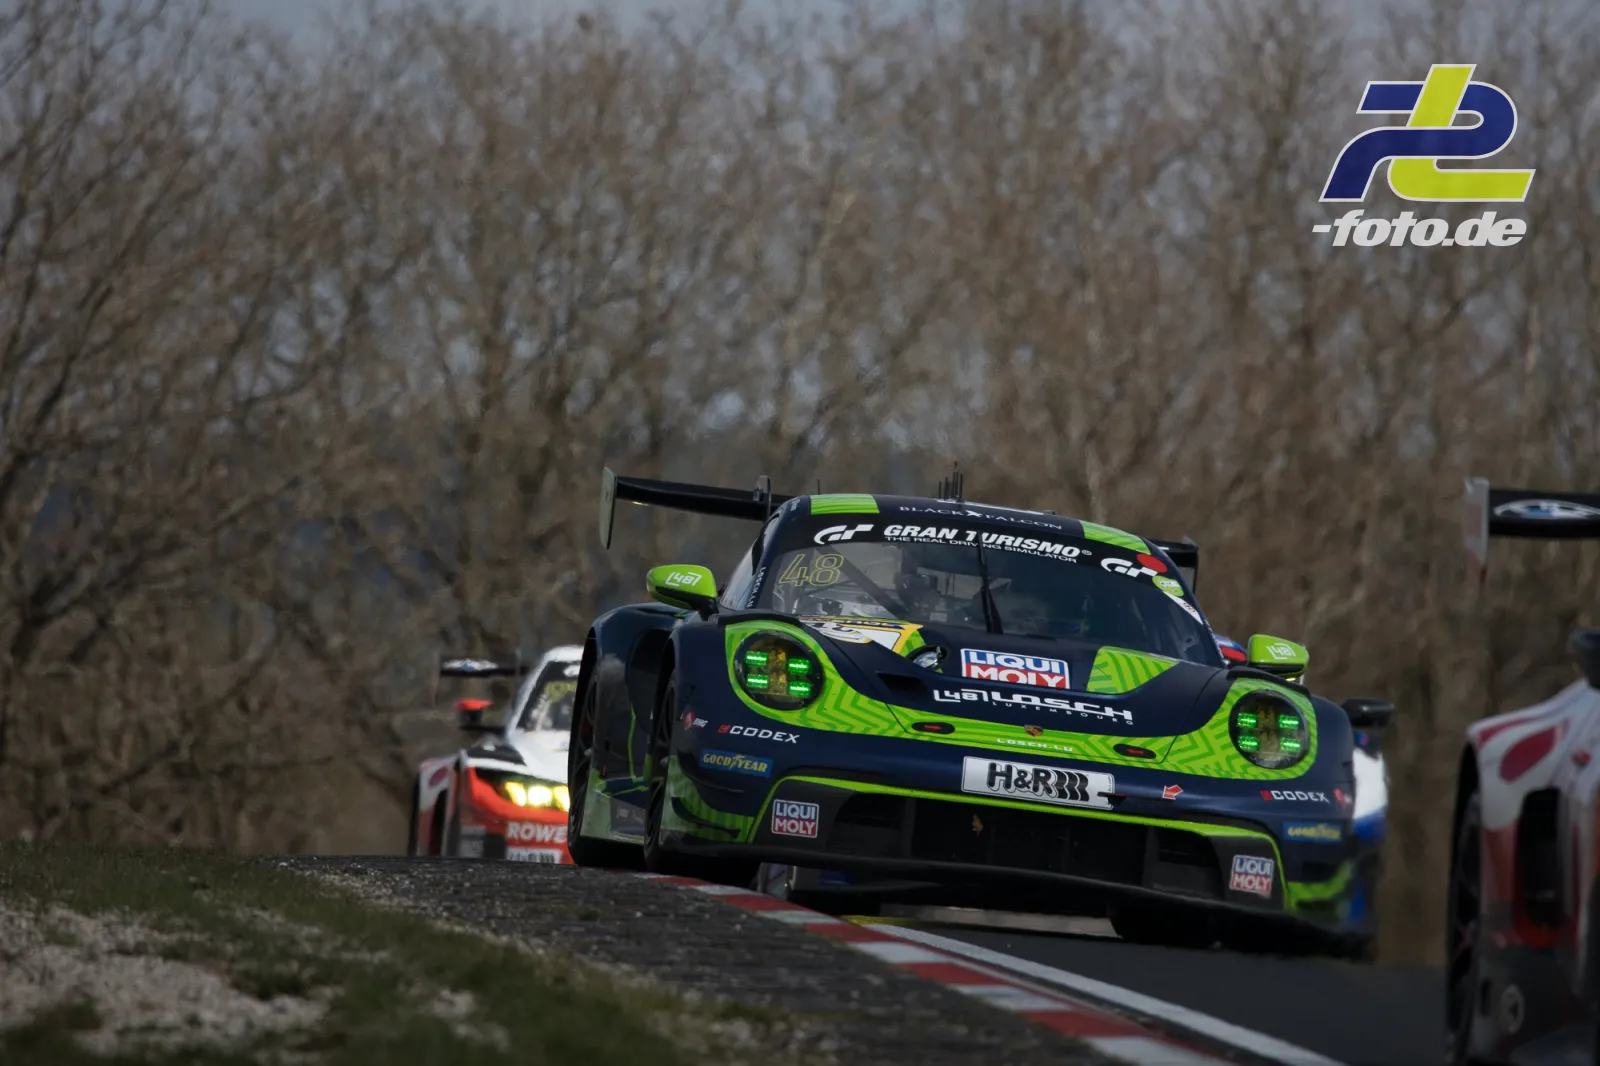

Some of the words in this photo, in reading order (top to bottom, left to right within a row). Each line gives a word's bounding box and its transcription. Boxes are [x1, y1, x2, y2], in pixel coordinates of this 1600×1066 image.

[898, 506, 964, 517] BLACK
[984, 514, 1063, 531] FALCON
[883, 524, 959, 540] GRAN
[914, 537, 947, 545] REAL
[949, 539, 1002, 551] DRIVNG
[1004, 545, 1078, 564] SIMULATOR
[778, 553, 844, 587] 48
[969, 651, 1061, 674] LIQUI
[970, 665, 1064, 688] MOLY
[991, 691, 1133, 721] LOSCH
[992, 702, 1134, 726] LUXEMBOURG
[729, 725, 801, 744] CODEX
[996, 738, 1073, 753] LOSCH.LU
[703, 752, 768, 774] GOODYEAR
[1270, 790, 1331, 804] CODEX
[776, 802, 816, 820] LIQUI
[507, 821, 568, 844] ROWE
[775, 817, 816, 835] MOLY
[1235, 857, 1272, 877] LIQUI
[1233, 874, 1271, 895] MOLY
